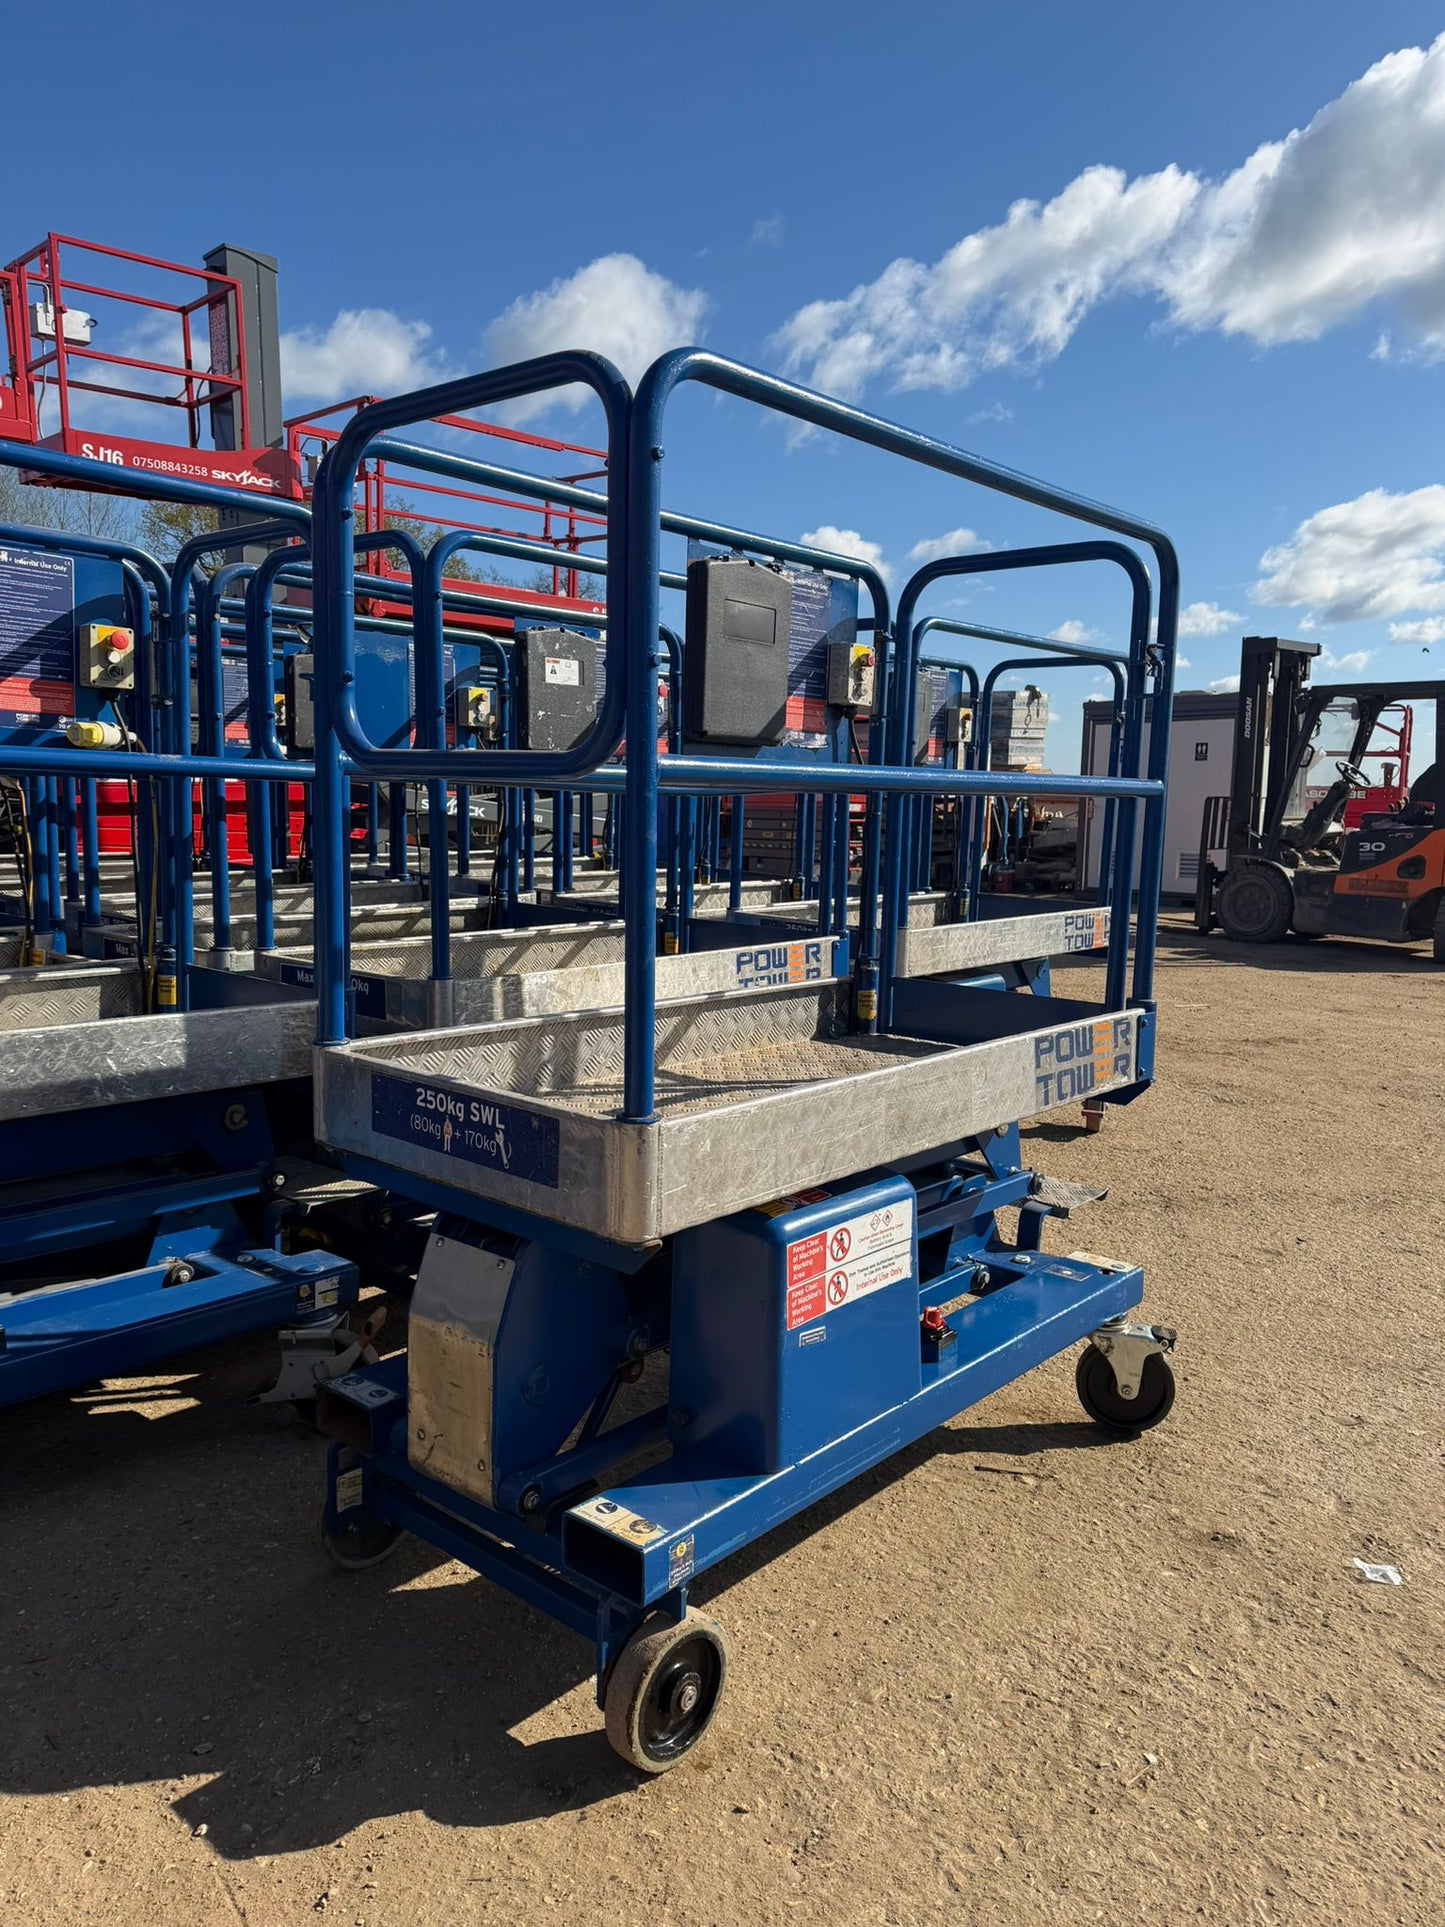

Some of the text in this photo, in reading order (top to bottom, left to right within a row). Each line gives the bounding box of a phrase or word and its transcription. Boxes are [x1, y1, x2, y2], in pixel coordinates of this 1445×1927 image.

[82, 443, 281, 489] SJ16 07508843258 SKYJACK
[53, 564, 67, 573] Only
[1244, 697, 1252, 738] DOOSAN
[1359, 842, 1386, 852] 30
[736, 943, 821, 974] POWER
[297, 969, 314, 983] Max
[1034, 1017, 1131, 1069] POWER
[1036, 1053, 1131, 1107] TOWER
[416, 1087, 505, 1129] 250kg SWL
[410, 1114, 441, 1139] (80kg
[454, 1129, 462, 1139] +
[464, 1130, 497, 1156] 170kg
[792, 1237, 820, 1254] Keep Clear
[792, 1254, 799, 1264] of
[792, 1258, 814, 1272] Working
[792, 1271, 806, 1281] Area
[857, 1266, 904, 1291] Internal Use Only
[791, 1282, 818, 1299] Keep Clear
[791, 1298, 797, 1308] of
[791, 1303, 812, 1318] Working
[792, 1316, 804, 1327] Area
